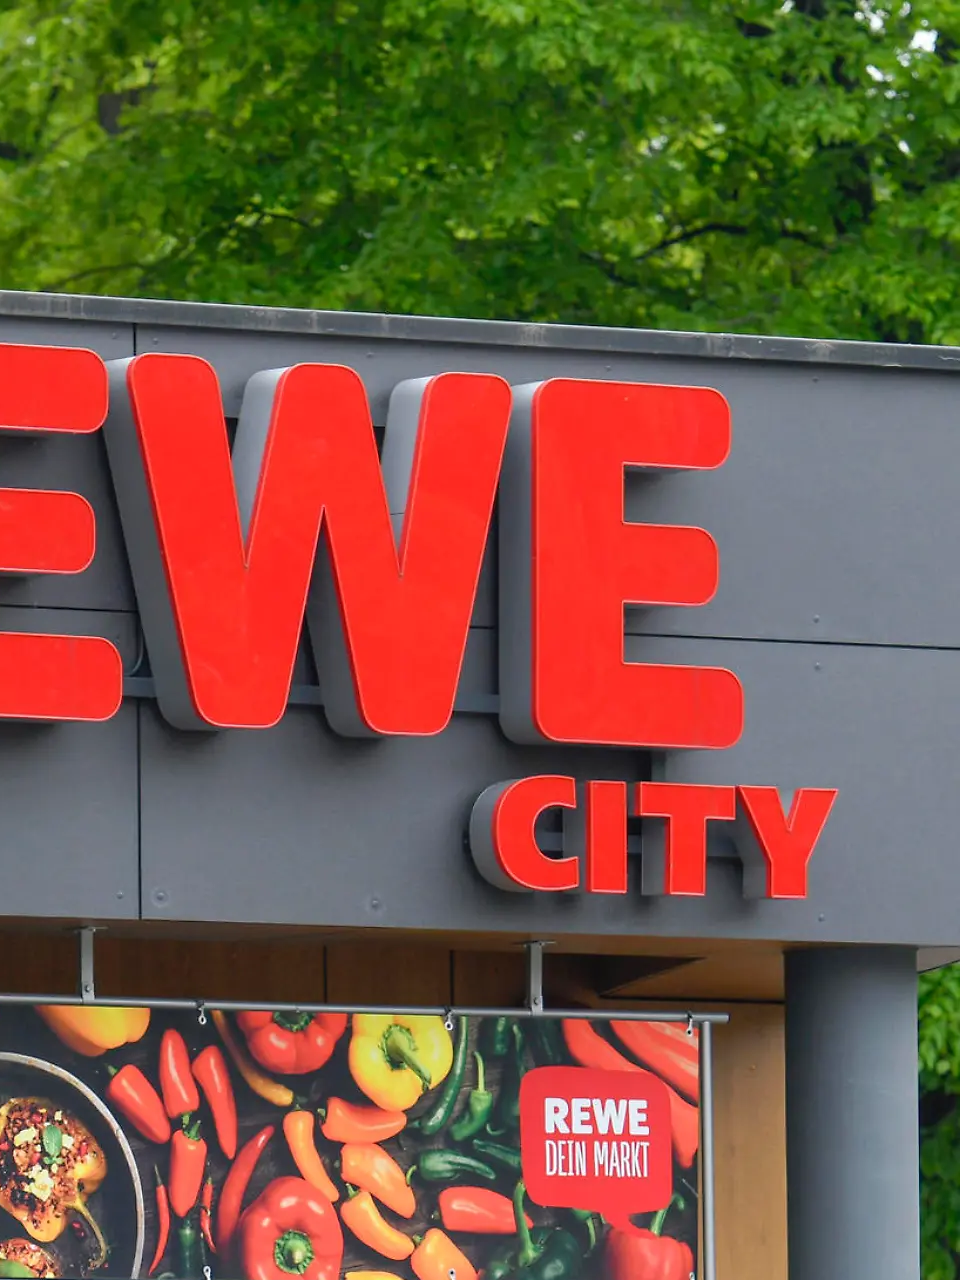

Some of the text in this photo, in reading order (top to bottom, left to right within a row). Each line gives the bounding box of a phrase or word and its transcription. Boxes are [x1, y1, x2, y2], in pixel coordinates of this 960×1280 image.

[475, 775, 838, 899] CITY
[544, 1097, 649, 1136] REWE
[545, 1140, 649, 1178] DEIN MARKT
